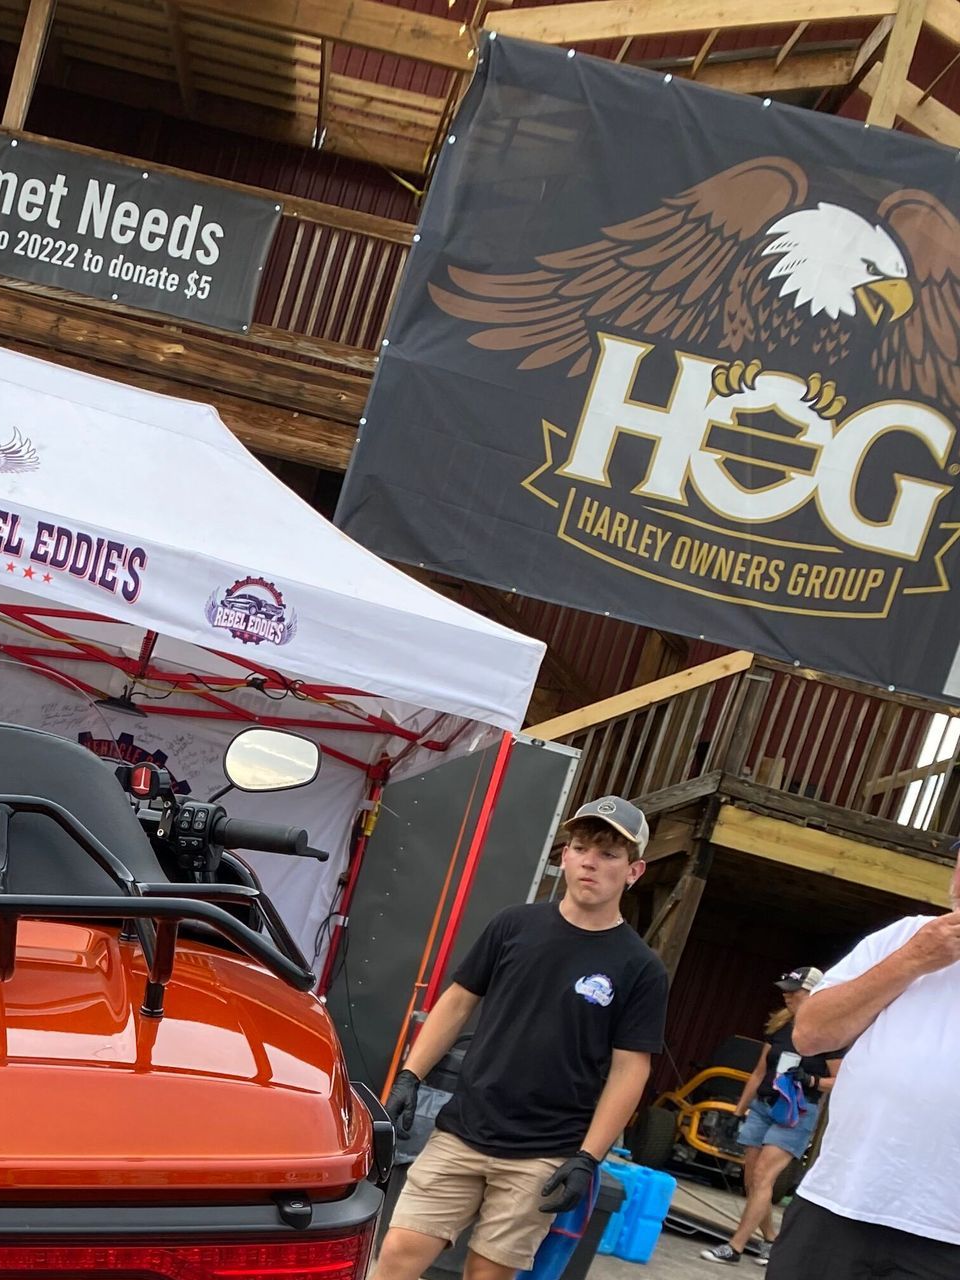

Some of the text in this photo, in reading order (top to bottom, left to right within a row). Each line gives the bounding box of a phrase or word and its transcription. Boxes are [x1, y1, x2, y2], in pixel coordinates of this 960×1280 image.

[13, 230, 80, 269] 20222
[81, 248, 104, 274] to
[108, 253, 180, 293] donate
[183, 269, 213, 300] $5
[76, 178, 225, 266] Needs
[554, 331, 957, 562] HOG
[29, 520, 148, 605] EDDIE'S
[576, 496, 886, 603] HARLEY OWNERS GROUP
[214, 606, 247, 630] REBEL
